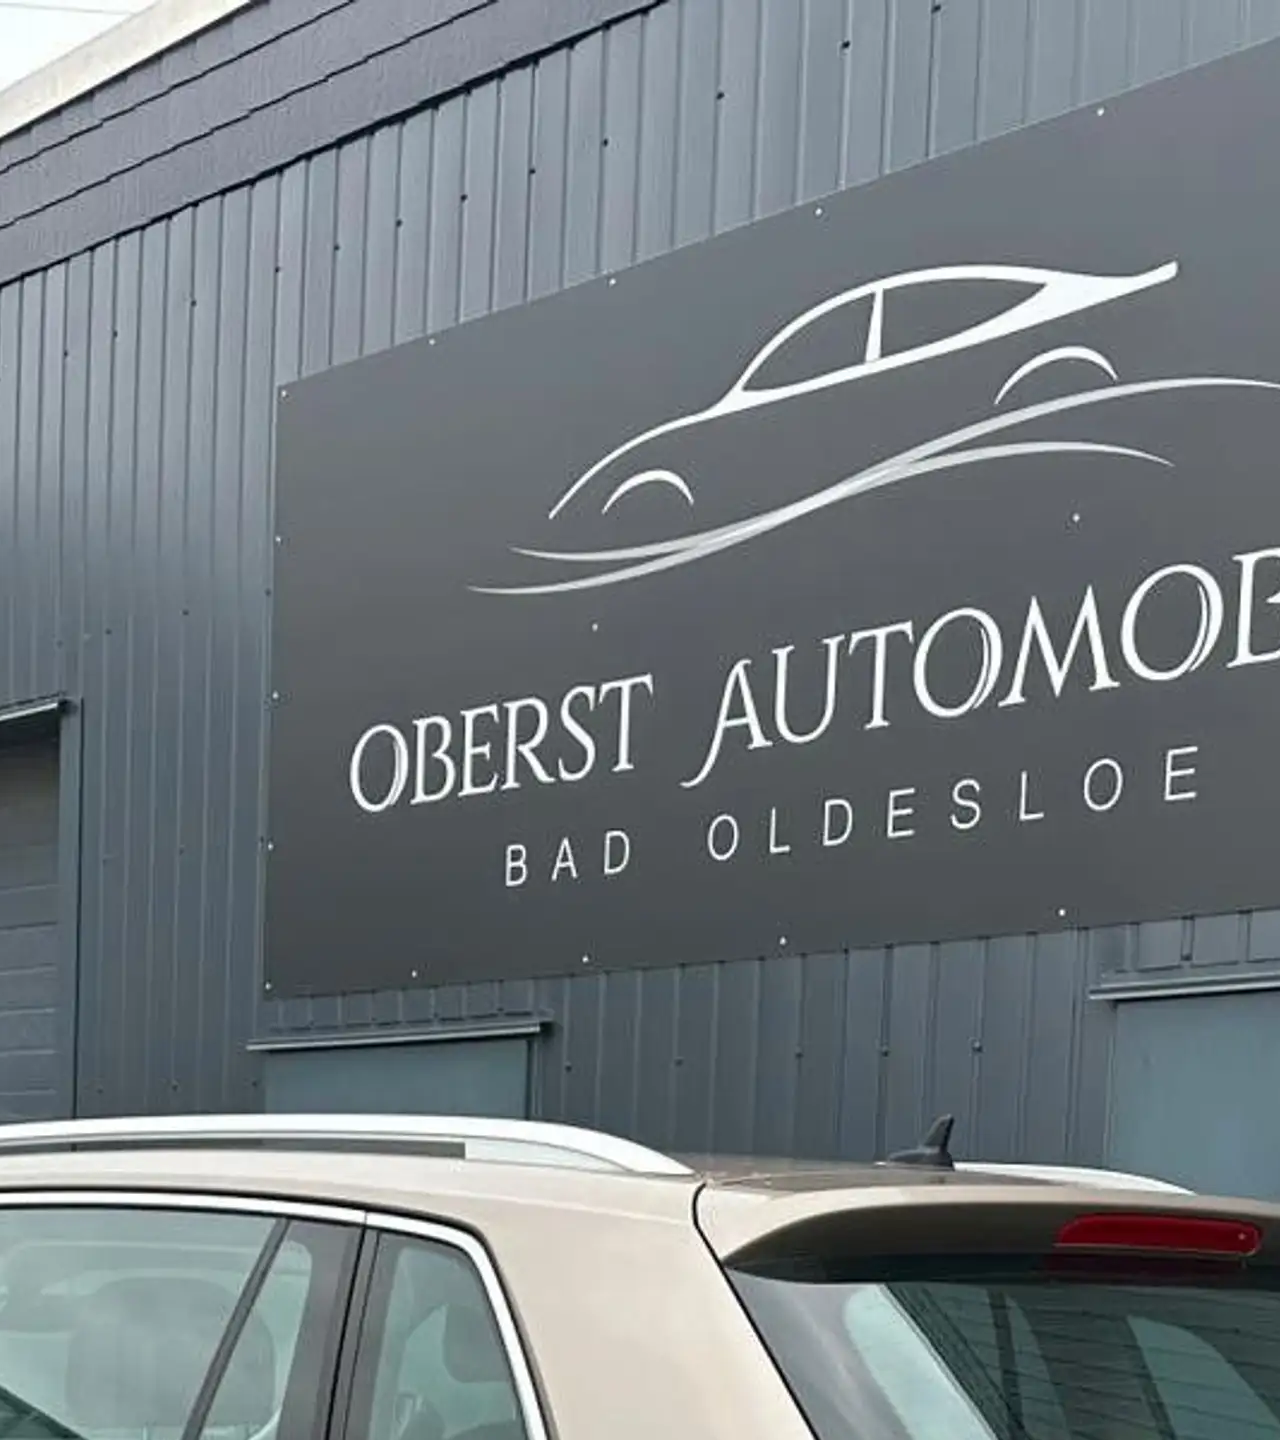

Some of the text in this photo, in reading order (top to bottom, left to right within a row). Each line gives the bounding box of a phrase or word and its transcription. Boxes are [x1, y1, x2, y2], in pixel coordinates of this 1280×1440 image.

[349, 673, 655, 813] OBERST
[505, 745, 1199, 887] BAD OLDESLOE
